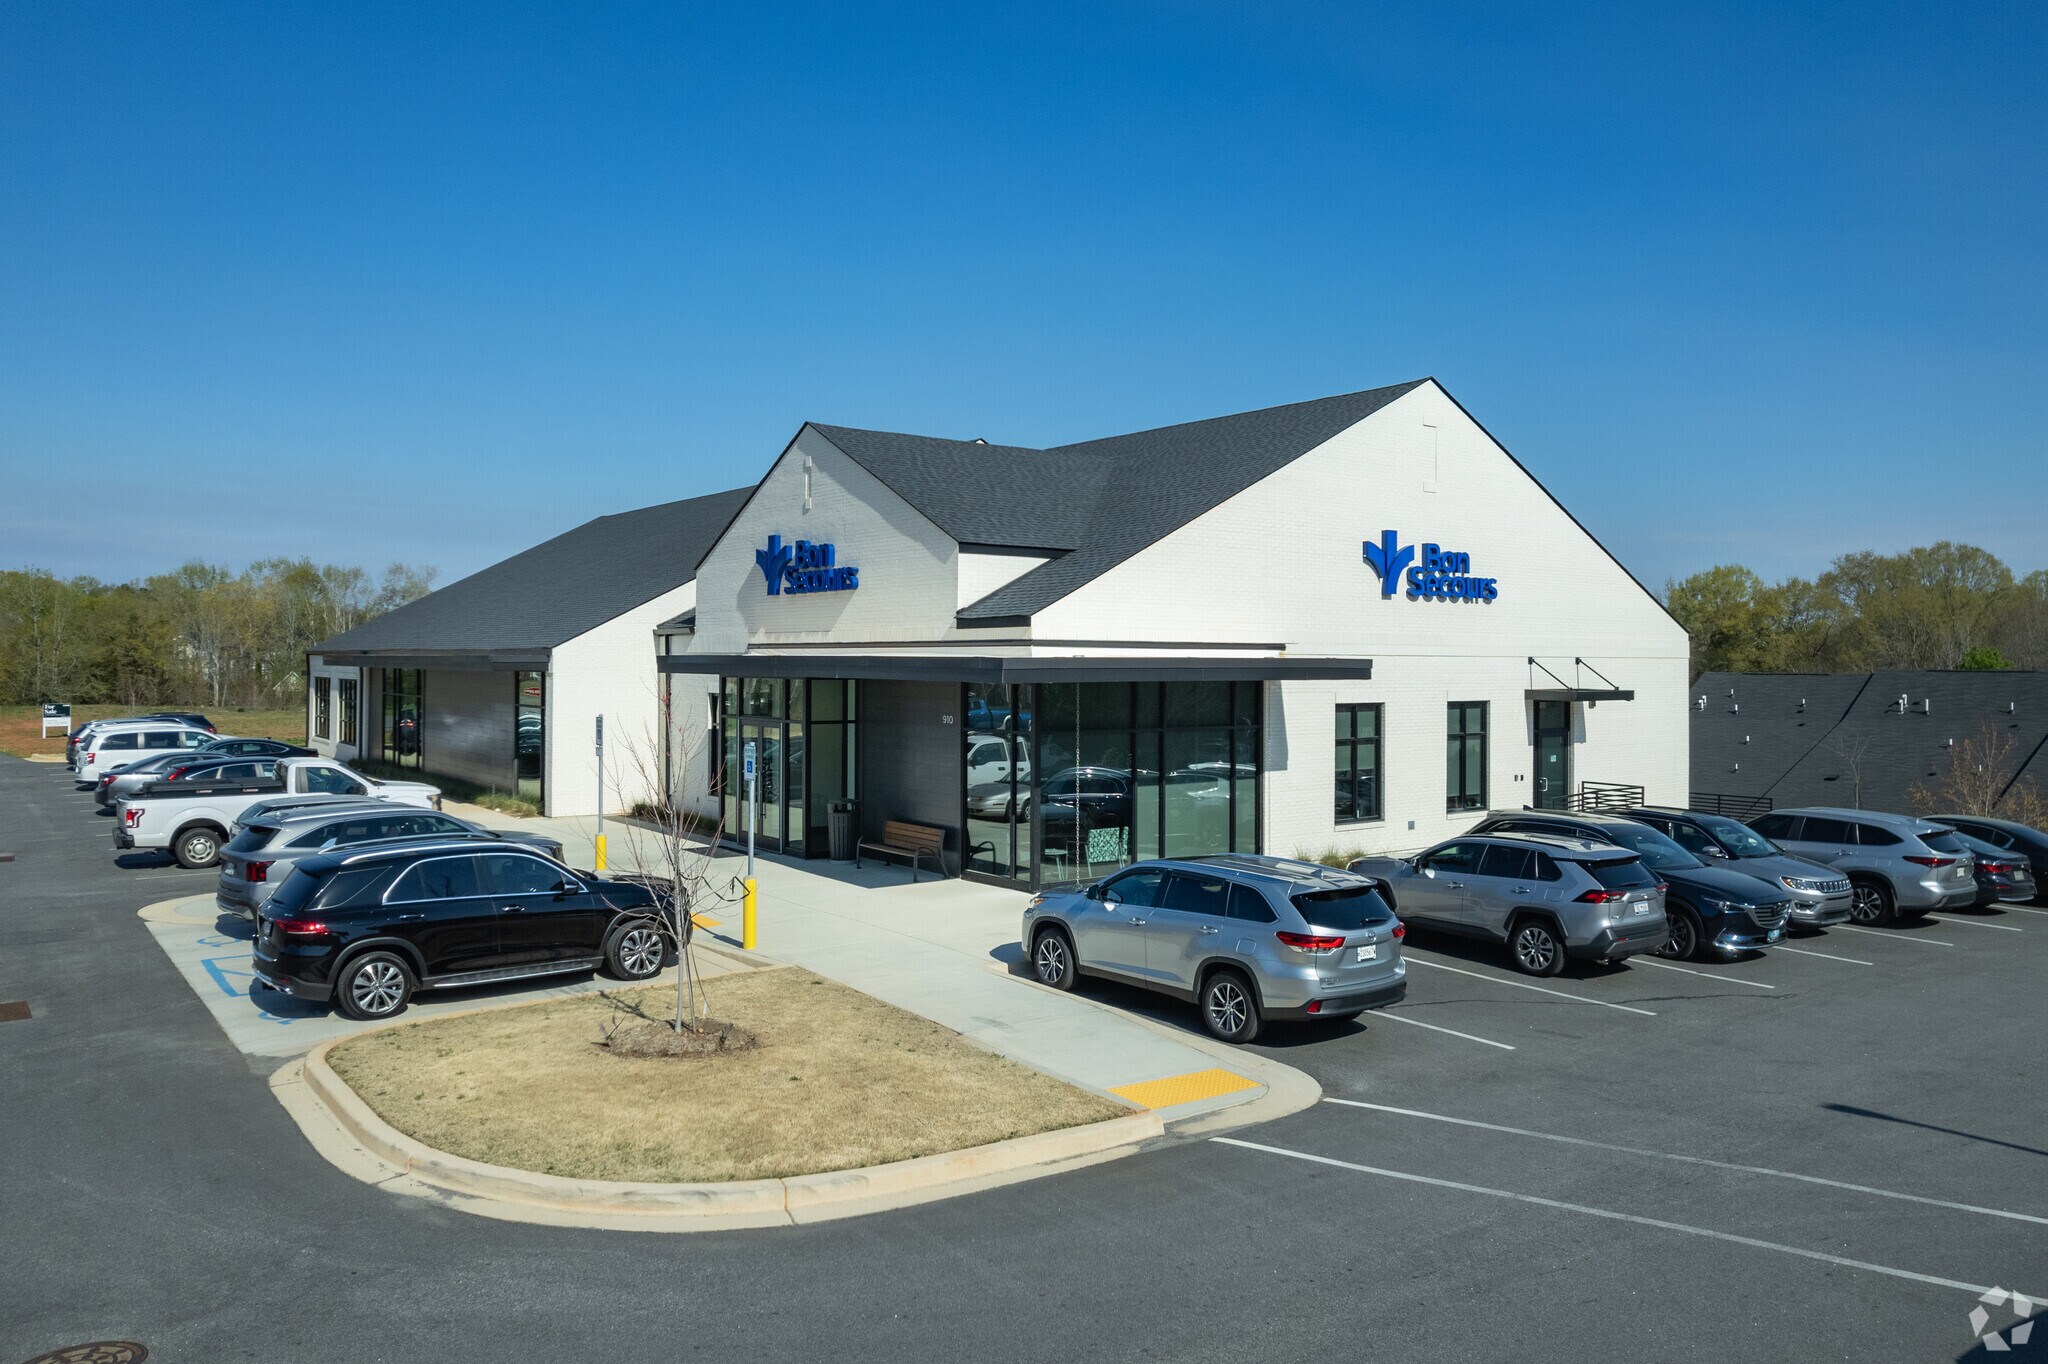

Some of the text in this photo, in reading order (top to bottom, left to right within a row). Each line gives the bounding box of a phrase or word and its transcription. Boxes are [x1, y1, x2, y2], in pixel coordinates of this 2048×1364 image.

[796, 541, 835, 568] Bon
[1422, 543, 1470, 573] Bon
[785, 565, 859, 594] Secours
[1406, 566, 1498, 601] Secours
[942, 714, 954, 724] 910
